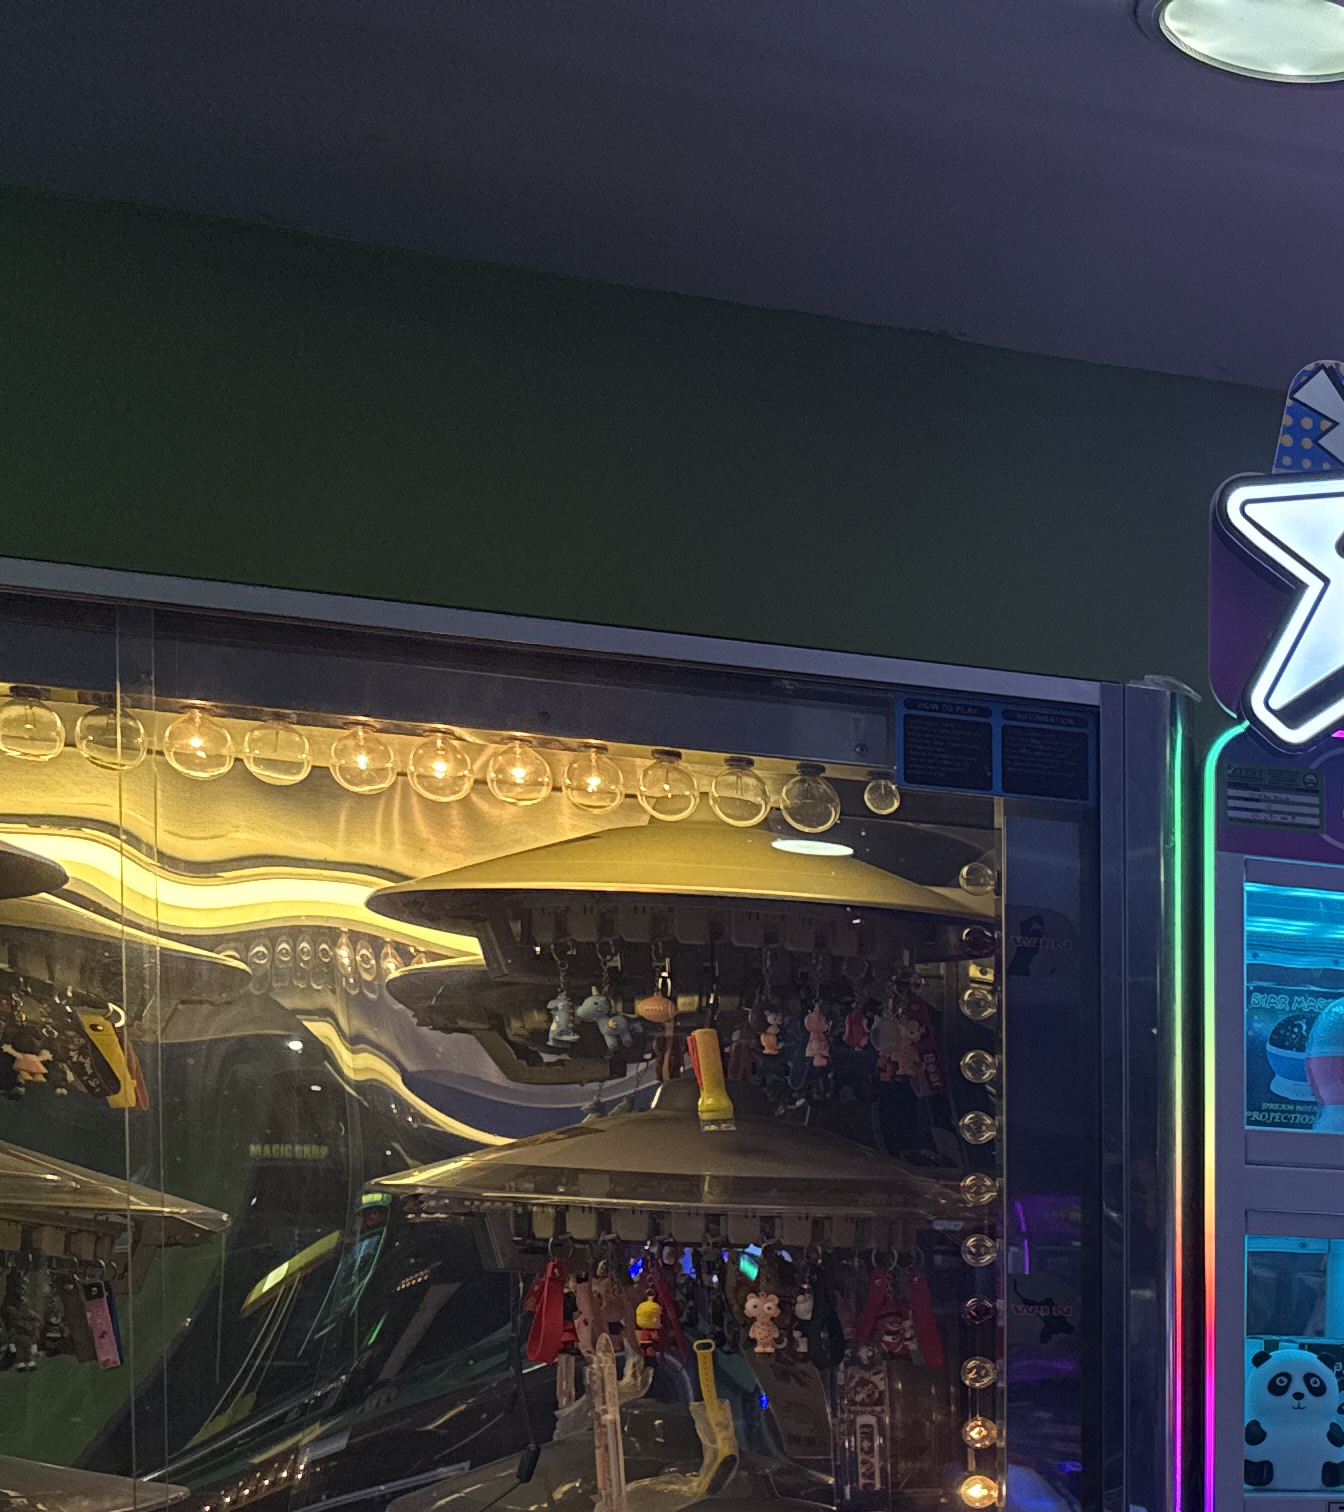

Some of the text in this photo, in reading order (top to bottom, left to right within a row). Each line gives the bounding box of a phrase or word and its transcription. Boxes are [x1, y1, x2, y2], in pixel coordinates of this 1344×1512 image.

[917, 702, 979, 716] HOW TO PLAY
[1010, 935, 1072, 950] WIN
[1250, 992, 1328, 1012] STAR MAS
[1011, 1305, 1073, 1317] WIN
